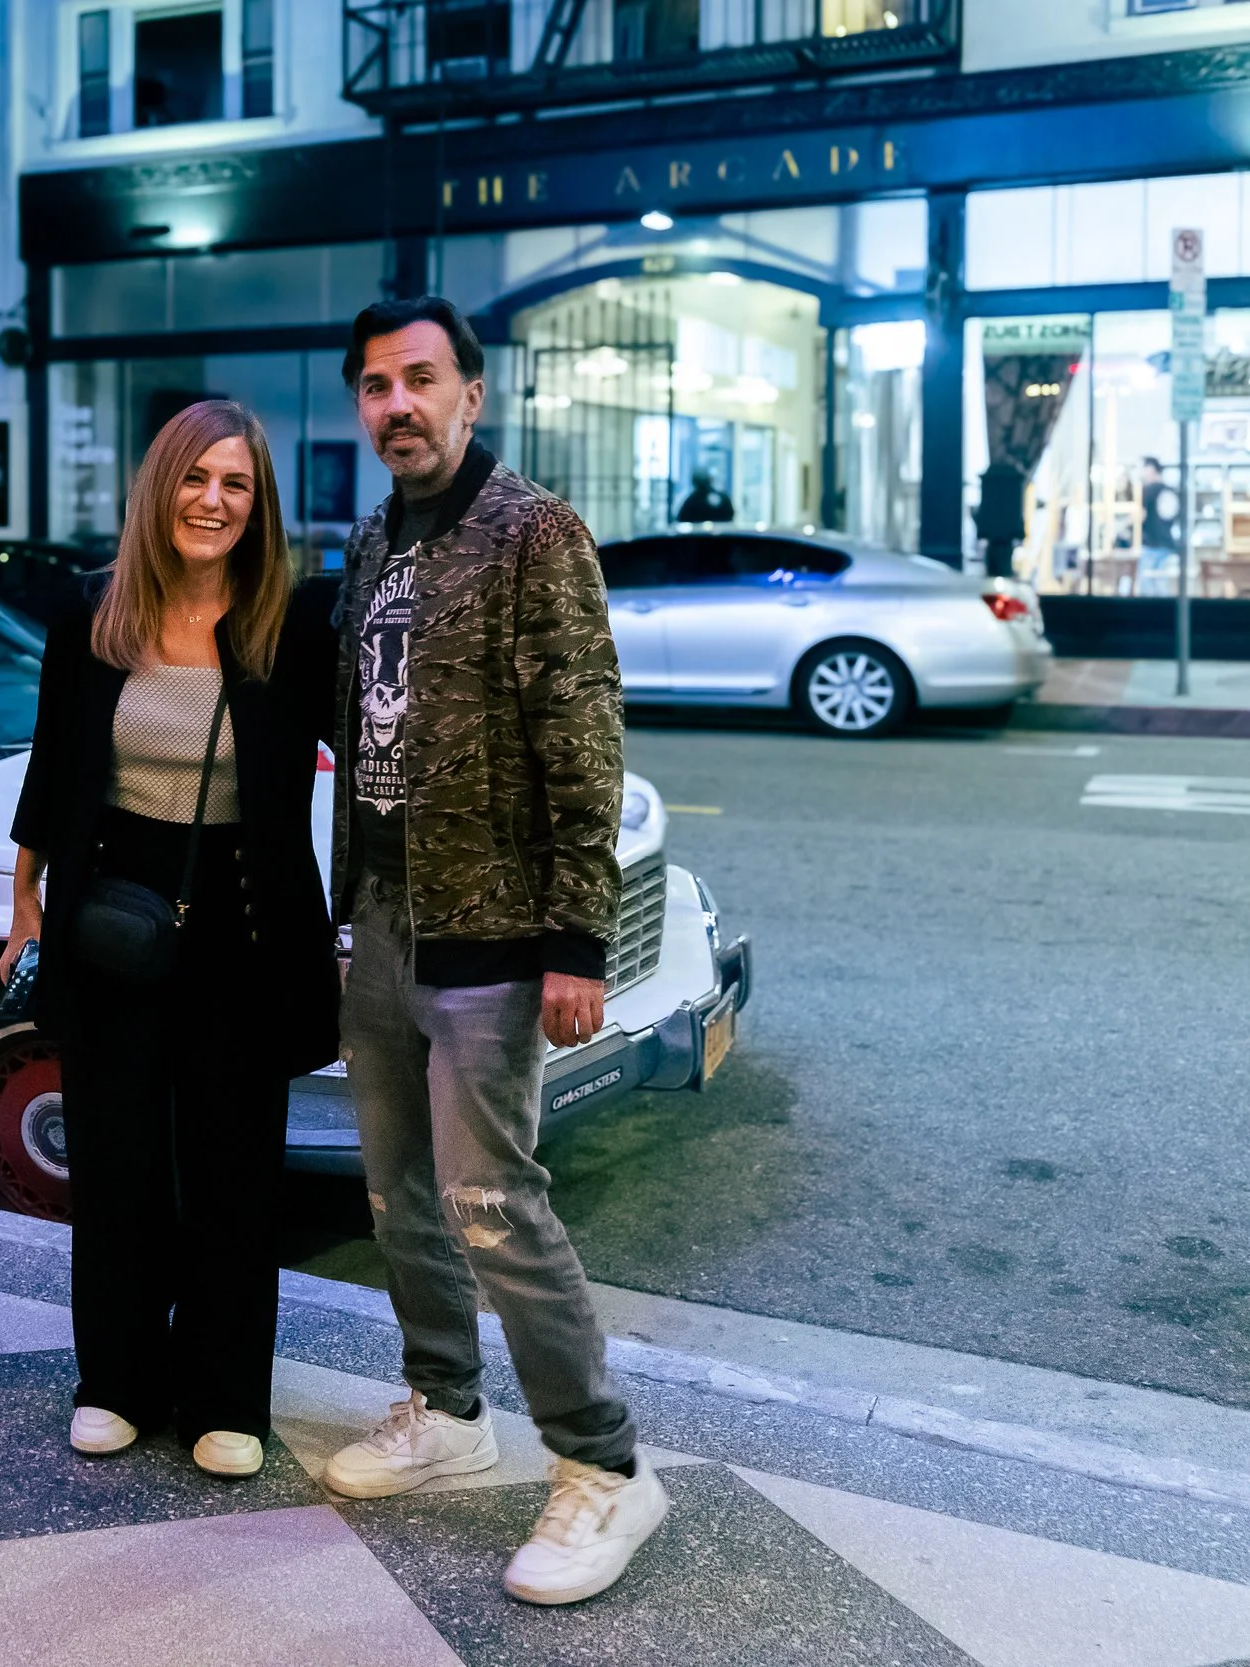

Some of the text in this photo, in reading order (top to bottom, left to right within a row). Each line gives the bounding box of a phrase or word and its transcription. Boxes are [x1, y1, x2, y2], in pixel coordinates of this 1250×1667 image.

[439, 140, 908, 208] THE ARCADE
[373, 785, 395, 796] CALI
